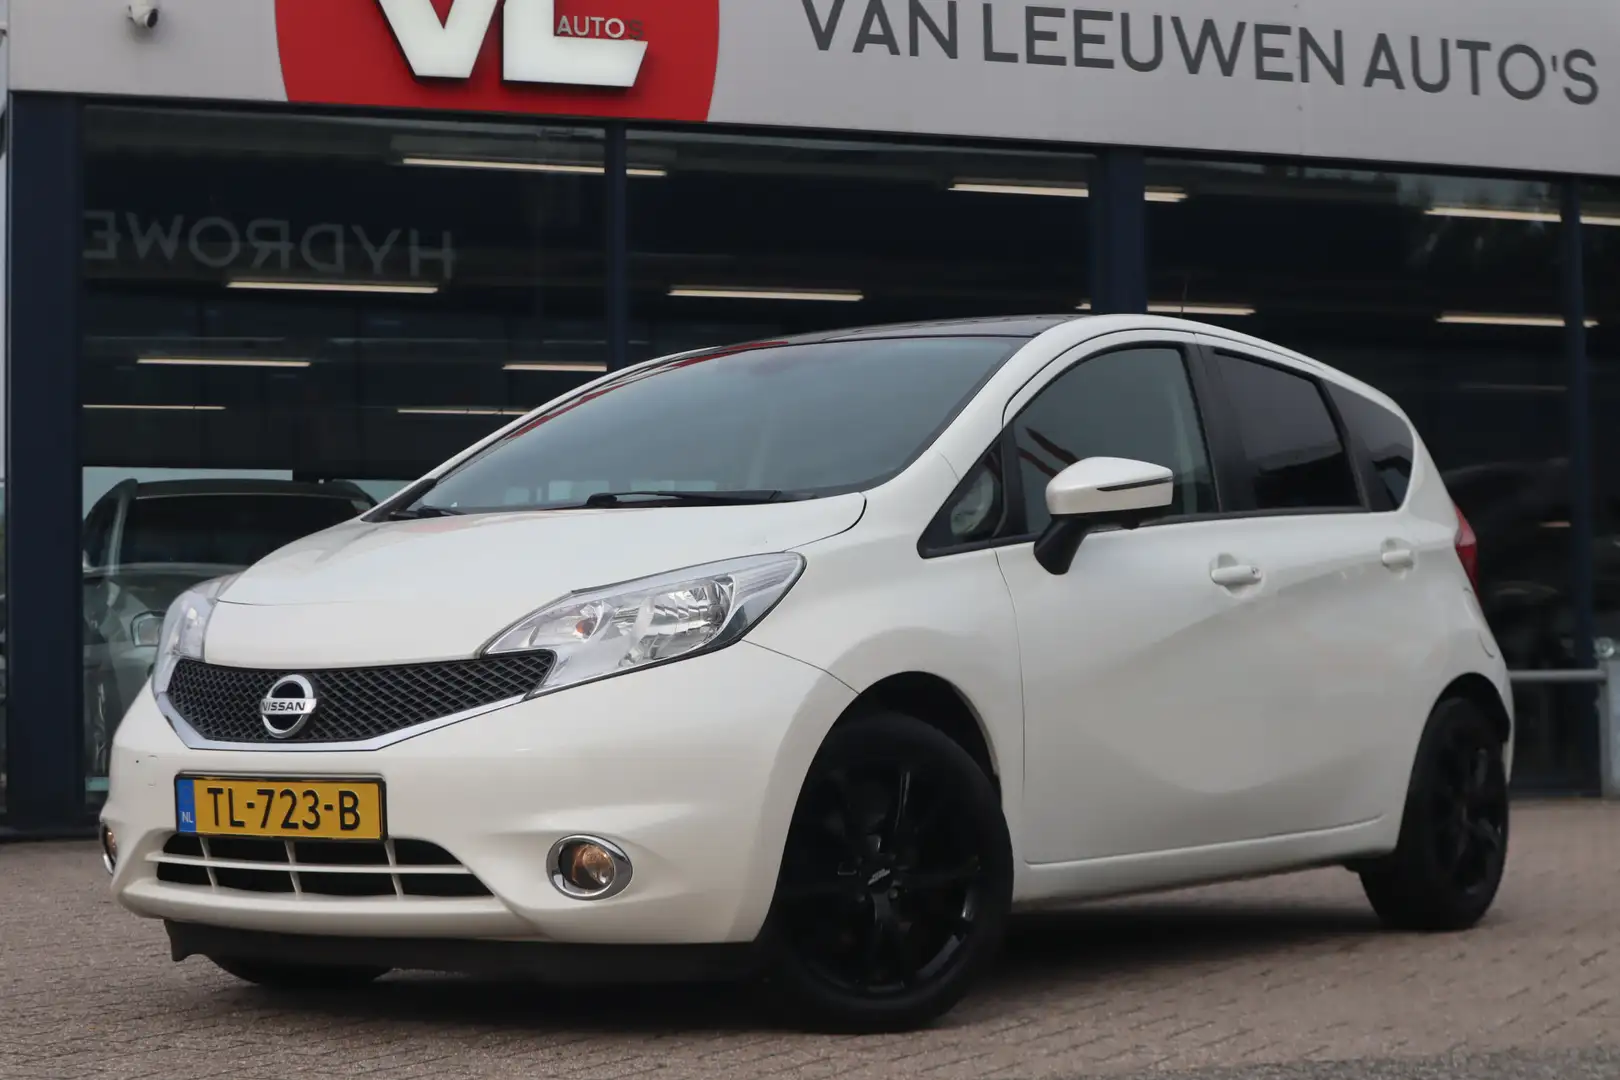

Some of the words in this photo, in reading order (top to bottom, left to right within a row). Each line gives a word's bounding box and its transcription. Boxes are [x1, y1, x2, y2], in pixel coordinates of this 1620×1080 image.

[556, 15, 644, 39] AUTO'S
[802, 0, 959, 60] VAN
[982, 2, 1345, 86] LEEUWEN
[1363, 32, 1599, 105] AUTO'S
[262, 701, 306, 712] NISSAN
[181, 811, 194, 823] NL
[206, 787, 361, 831] TL-723-B
